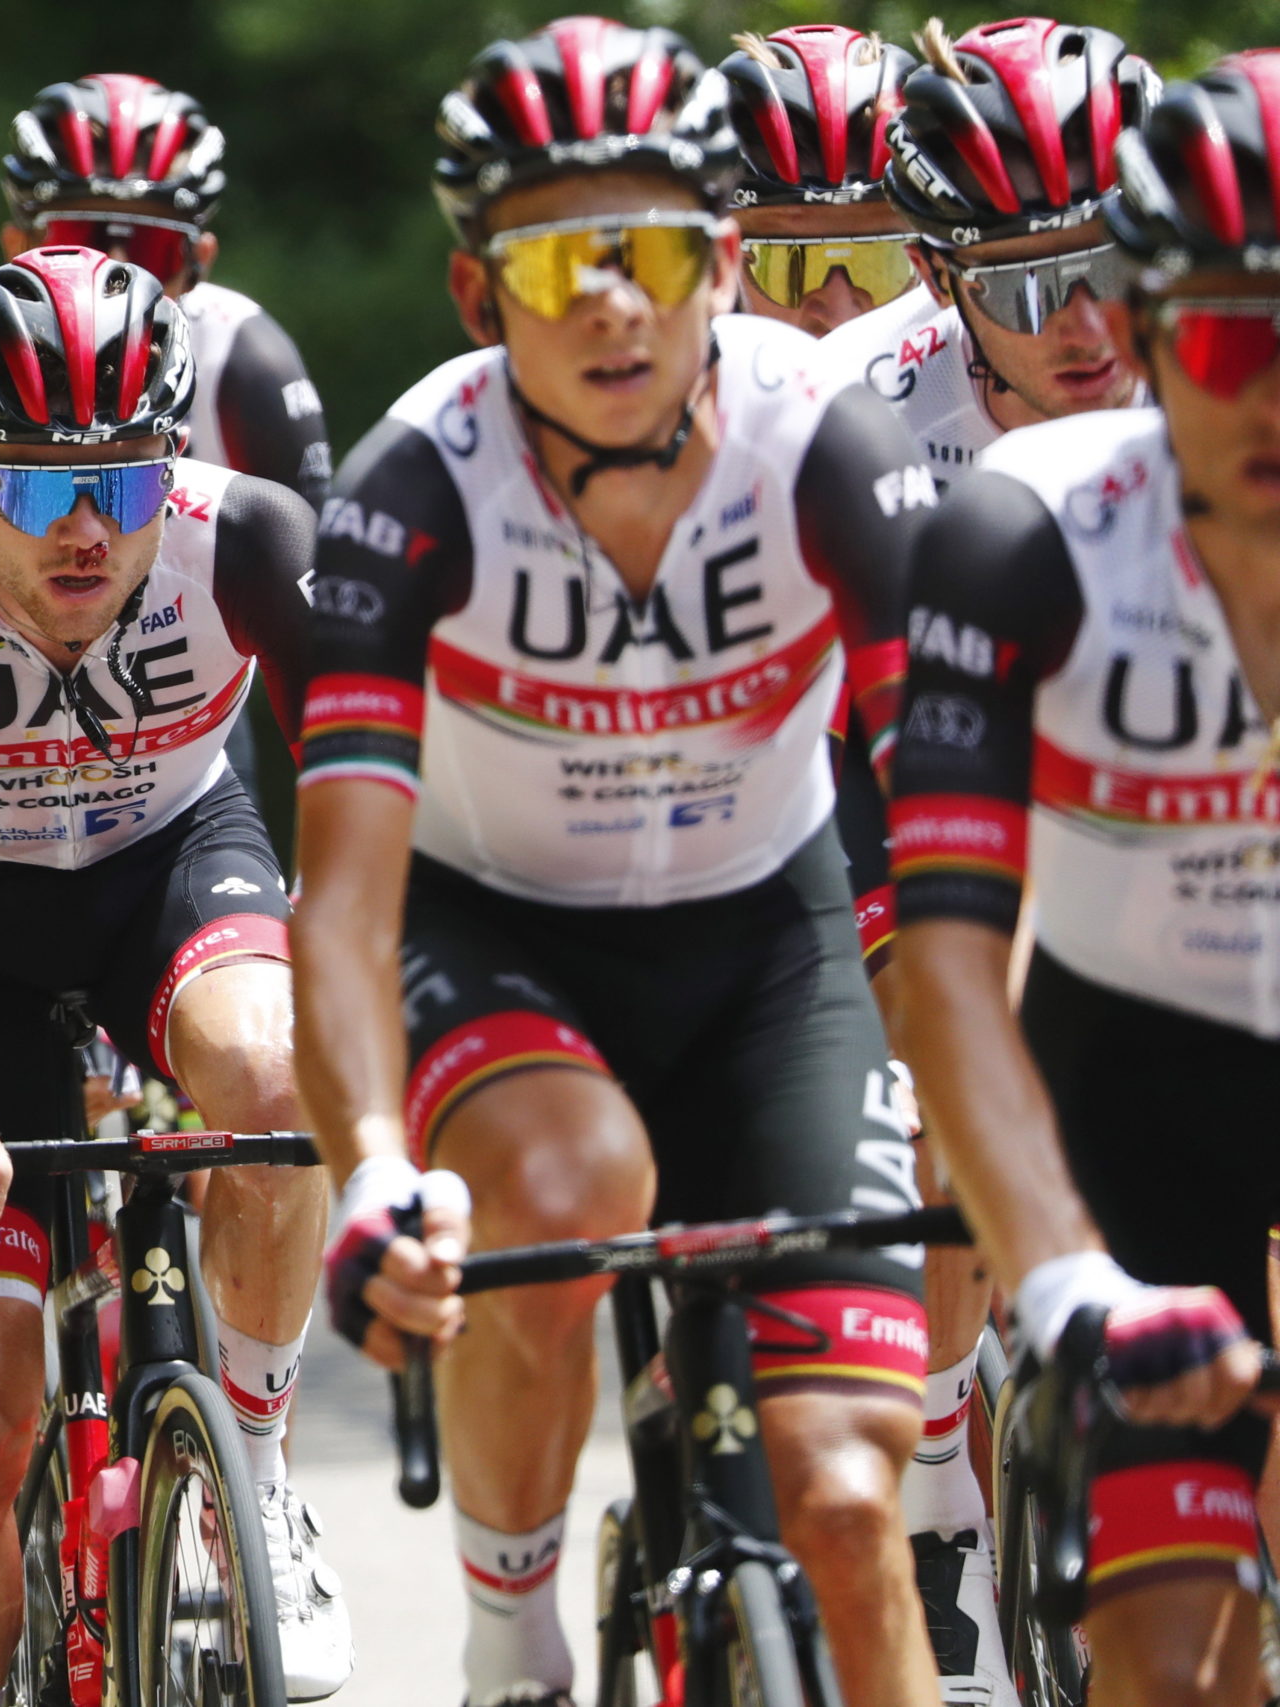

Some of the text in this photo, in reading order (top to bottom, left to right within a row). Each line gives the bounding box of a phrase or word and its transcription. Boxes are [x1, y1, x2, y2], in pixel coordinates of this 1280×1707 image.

[889, 124, 956, 200] MET
[804, 191, 865, 205] MET
[1029, 201, 1101, 233] MET
[952, 227, 980, 245] G42
[864, 326, 948, 402] G42
[51, 428, 117, 445] MET
[168, 486, 213, 522] 42
[873, 463, 940, 518] FA
[508, 536, 774, 665] UAE
[140, 606, 177, 635] FAB
[499, 660, 792, 735] Emirates
[17, 782, 156, 809] COLNAGO
[0, 833, 68, 841] ADNOC
[151, 1139, 186, 1150] SRM
[64, 1393, 107, 1417] UAE
